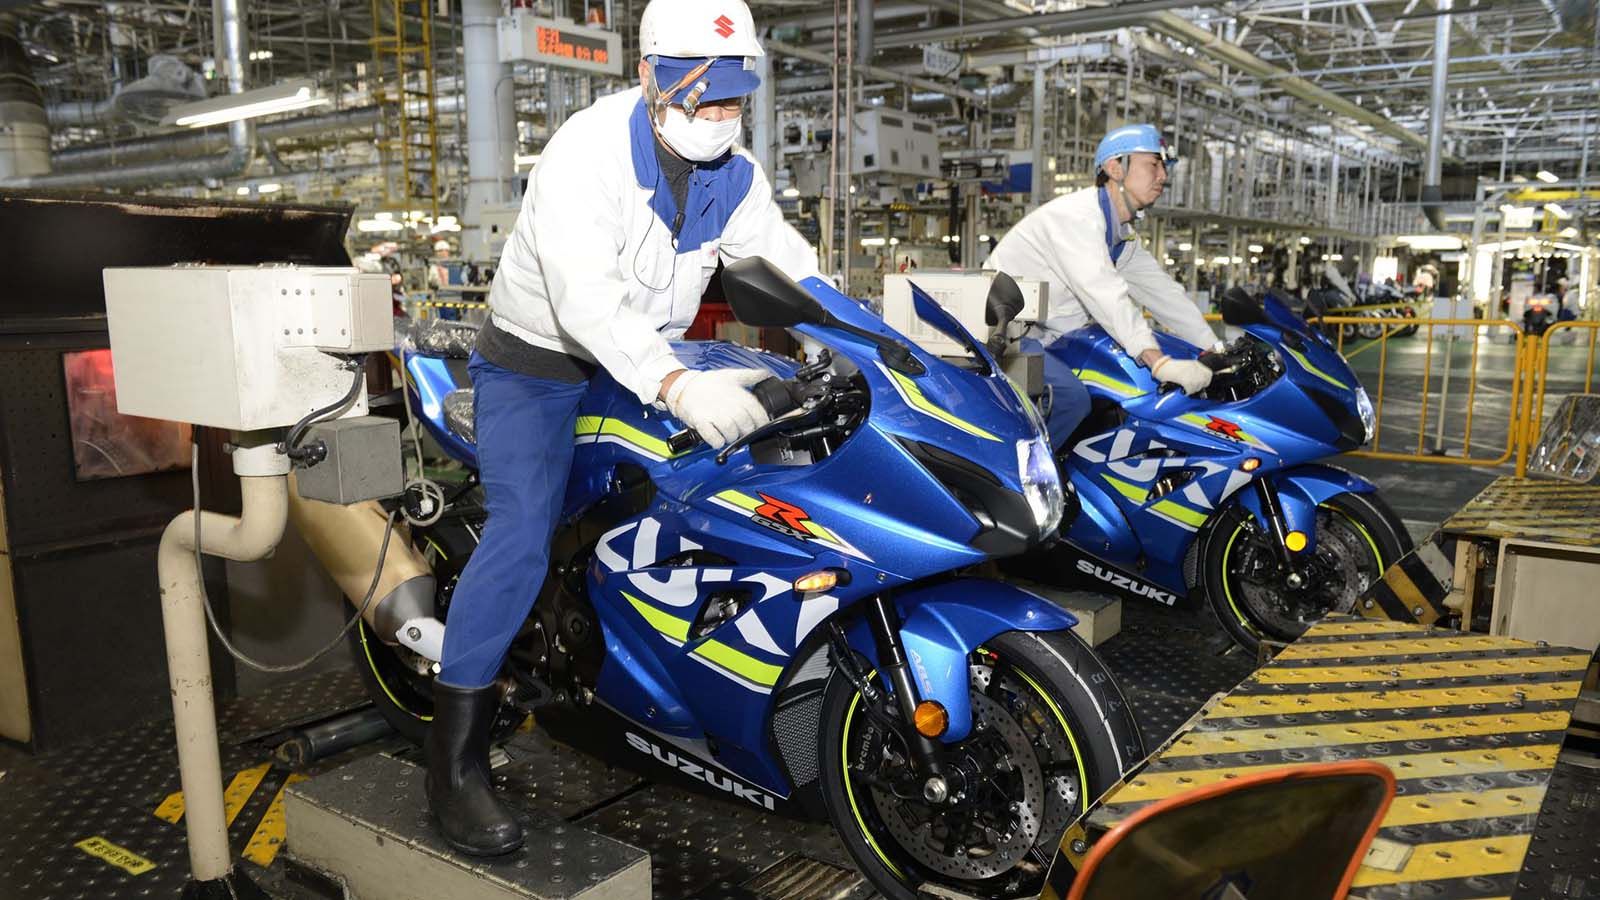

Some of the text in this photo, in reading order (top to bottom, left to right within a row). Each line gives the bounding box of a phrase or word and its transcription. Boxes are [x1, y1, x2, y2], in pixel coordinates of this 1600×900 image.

[751, 513, 812, 542] GSX
[756, 490, 818, 539] R
[1076, 559, 1177, 606] SUZUKI
[624, 731, 775, 811] SUZUKI
[855, 726, 875, 771] brembo
